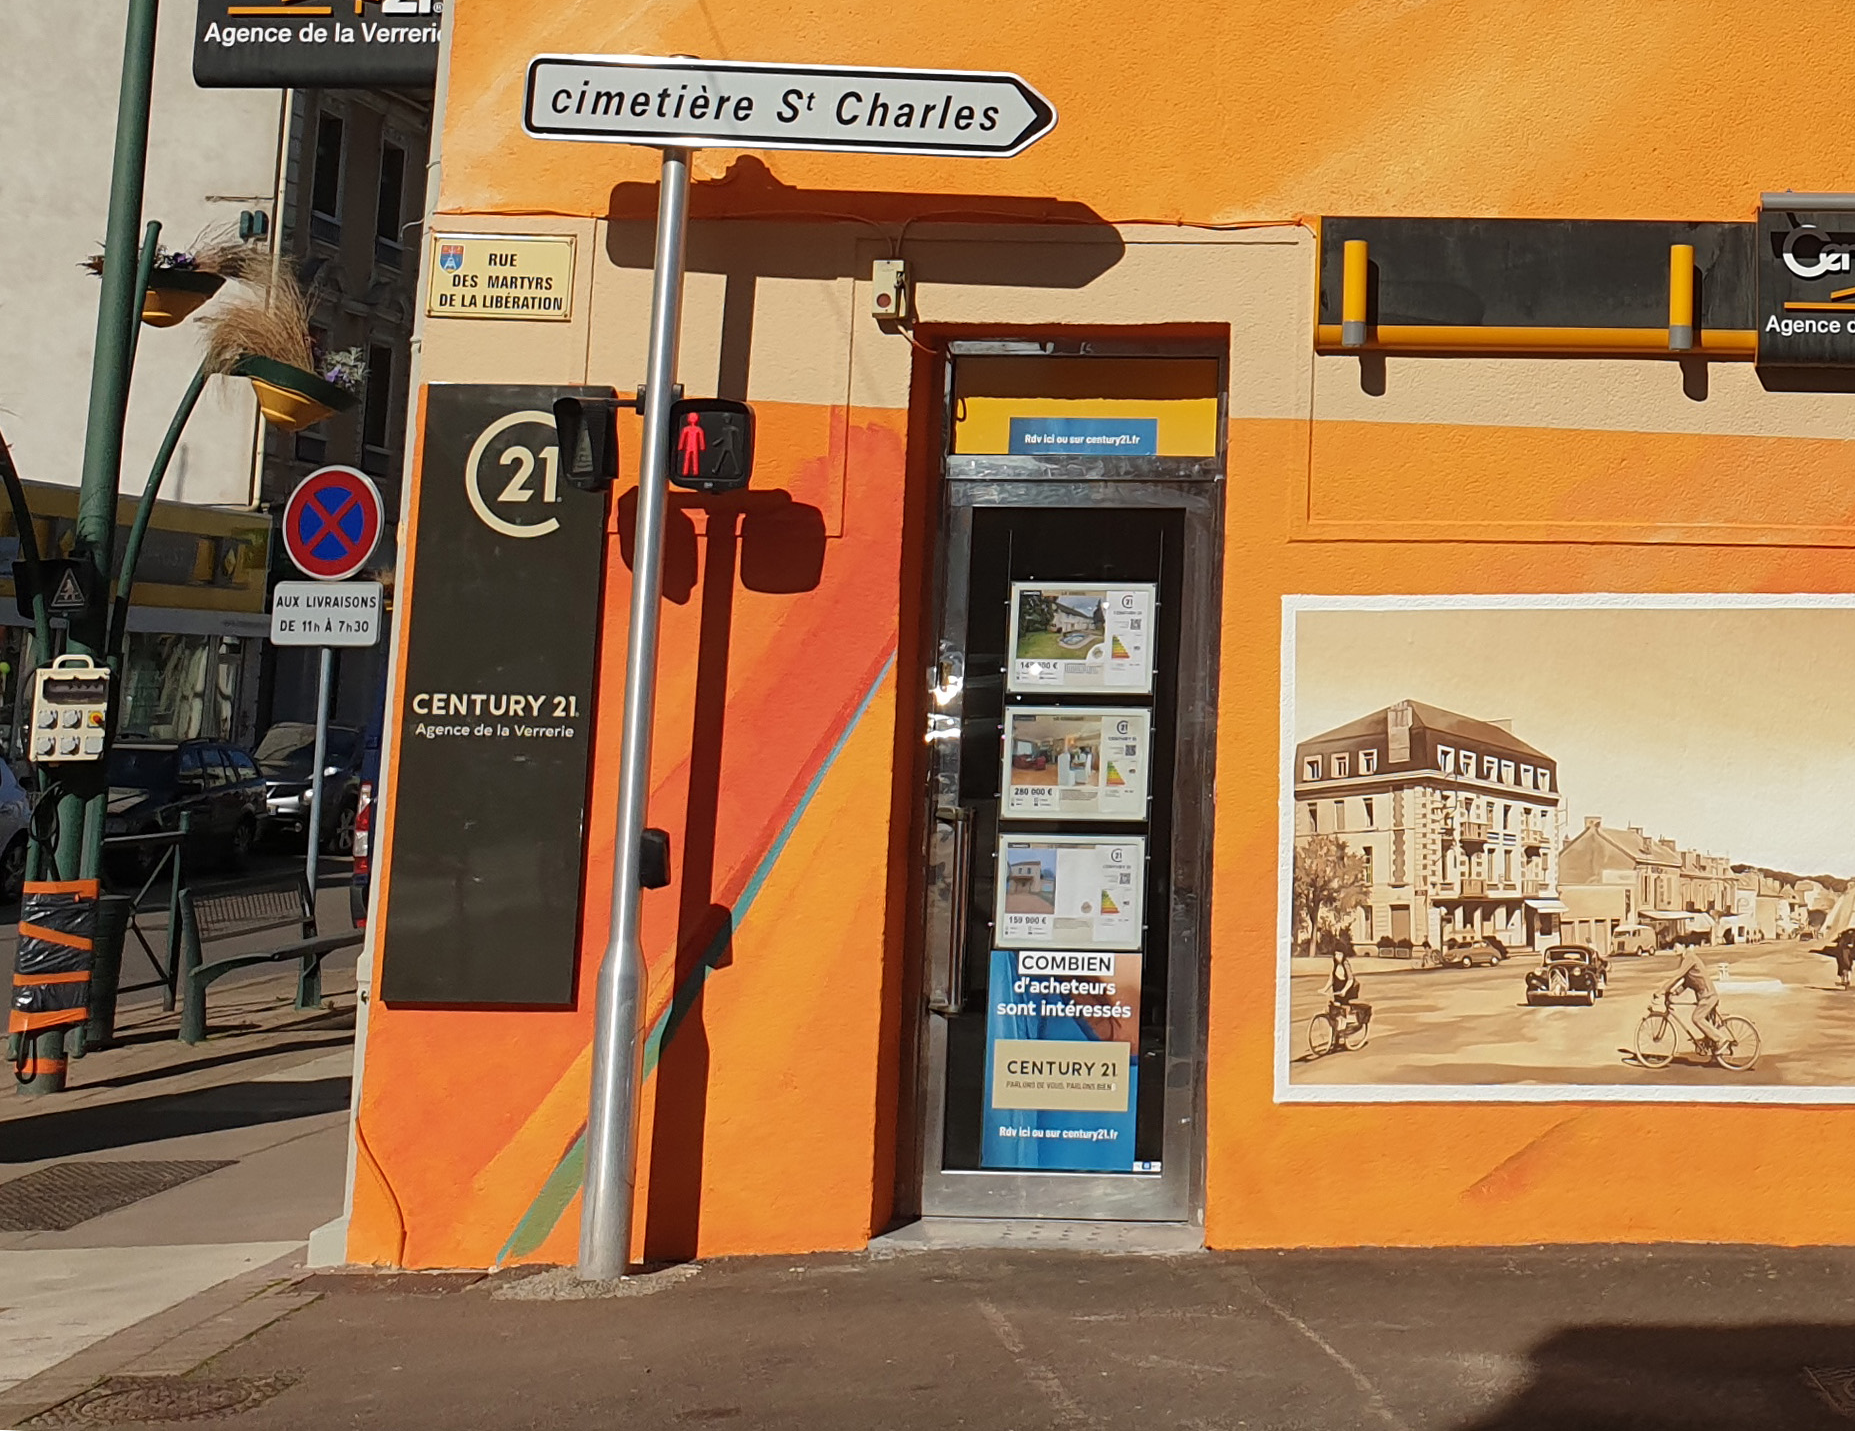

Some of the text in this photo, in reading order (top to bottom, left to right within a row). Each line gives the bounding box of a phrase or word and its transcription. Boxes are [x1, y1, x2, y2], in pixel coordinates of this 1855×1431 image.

[203, 23, 292, 47] Agence
[299, 23, 328, 43] de
[334, 23, 354, 43] la
[551, 79, 1000, 131] cimetière St Charles
[488, 253, 518, 267] RUE
[452, 274, 554, 291] DES MARTYRS
[439, 292, 563, 311] DE LA LIBÉRATION
[1765, 315, 1841, 336] Agence
[1024, 434, 1140, 447] Rdv ici ou sur century21.fr
[276, 596, 377, 609] AUX LIVRAISONS
[280, 620, 296, 632] DE
[302, 620, 320, 633] 11h
[324, 617, 333, 633] À
[1020, 661, 1034, 670] 14
[412, 693, 577, 718] CENTURY 21
[415, 723, 575, 740] Agence de la Verrerie
[1021, 955, 1112, 972] COMBIEN
[1014, 977, 1116, 995] d'acheteurs
[997, 999, 1131, 1018] sont intéressés
[1007, 1060, 1117, 1077] CENTURY 21
[999, 1126, 1119, 1142] Rdv ici ou sur century21.fr
